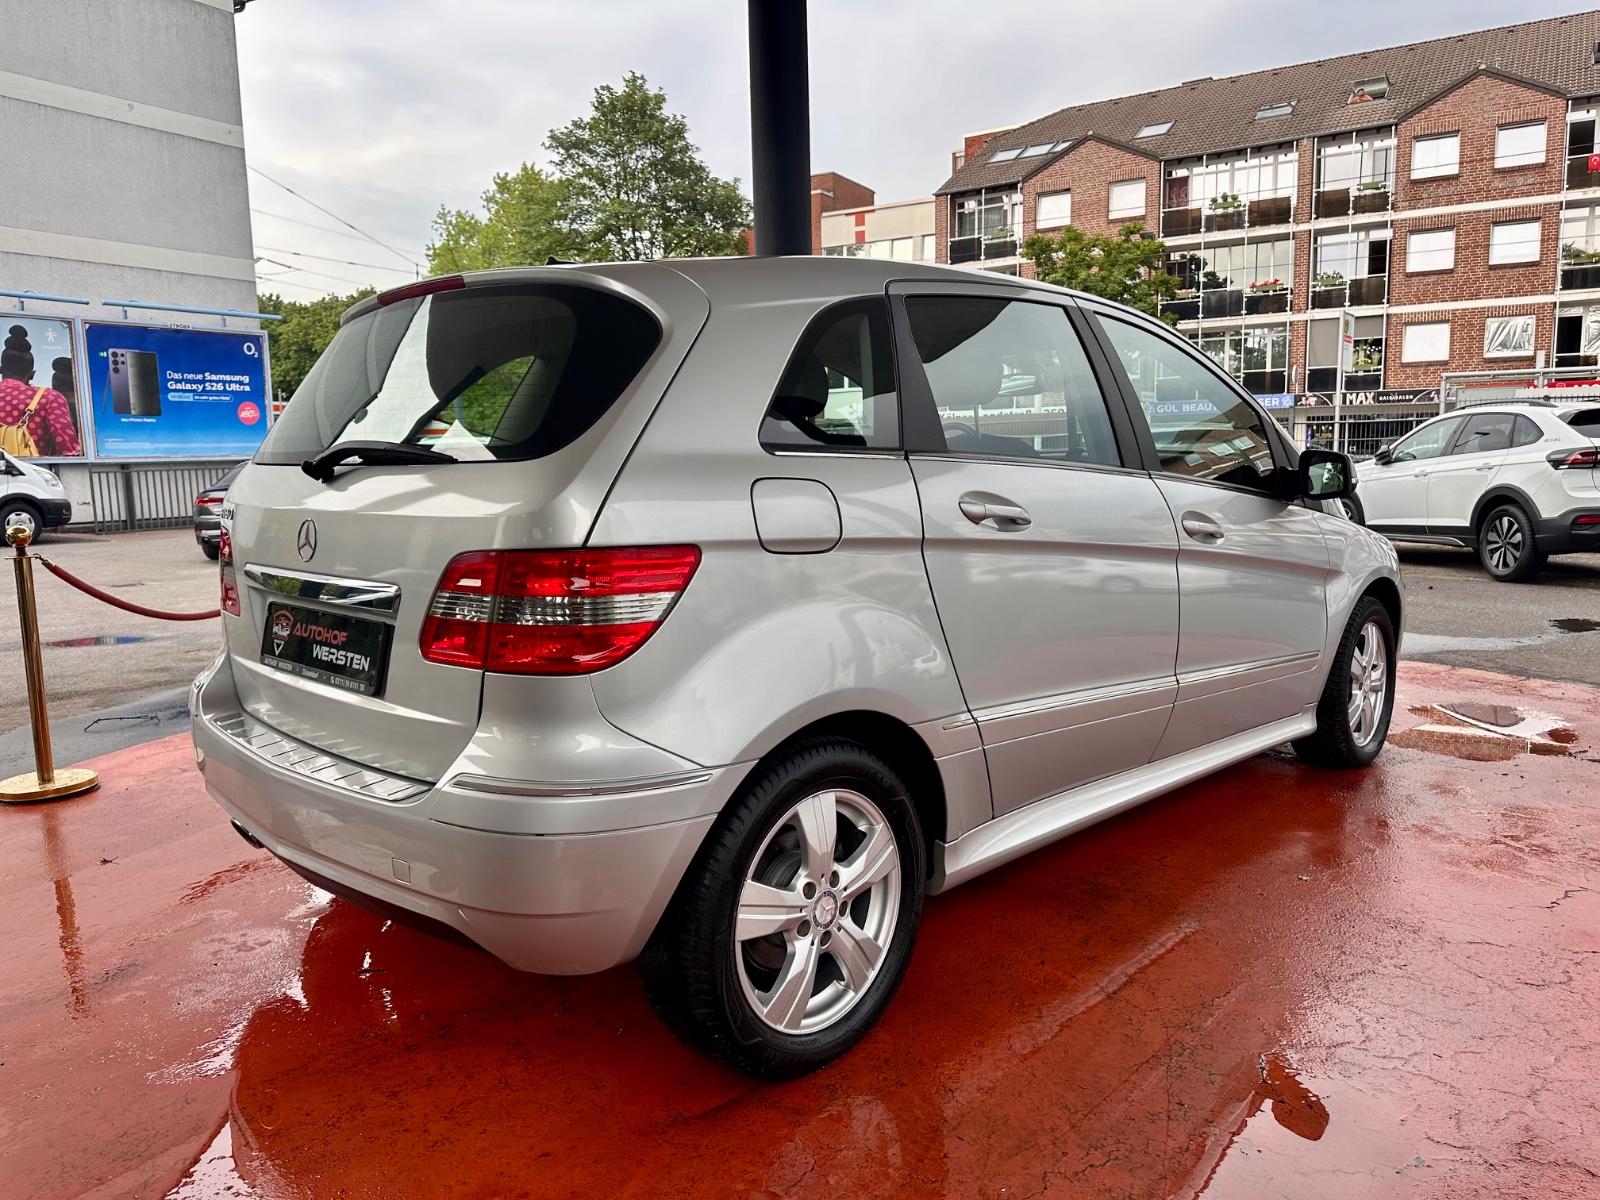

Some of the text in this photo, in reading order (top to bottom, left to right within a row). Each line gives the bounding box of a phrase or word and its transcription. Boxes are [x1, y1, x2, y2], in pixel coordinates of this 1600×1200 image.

[166, 370, 182, 380] Das
[204, 372, 250, 384] Samsung
[167, 381, 251, 393] Galaxy S26 Ultra
[1346, 392, 1376, 405] MAX
[293, 622, 349, 645] AUTOHOF
[312, 643, 370, 672] WERSTEN
